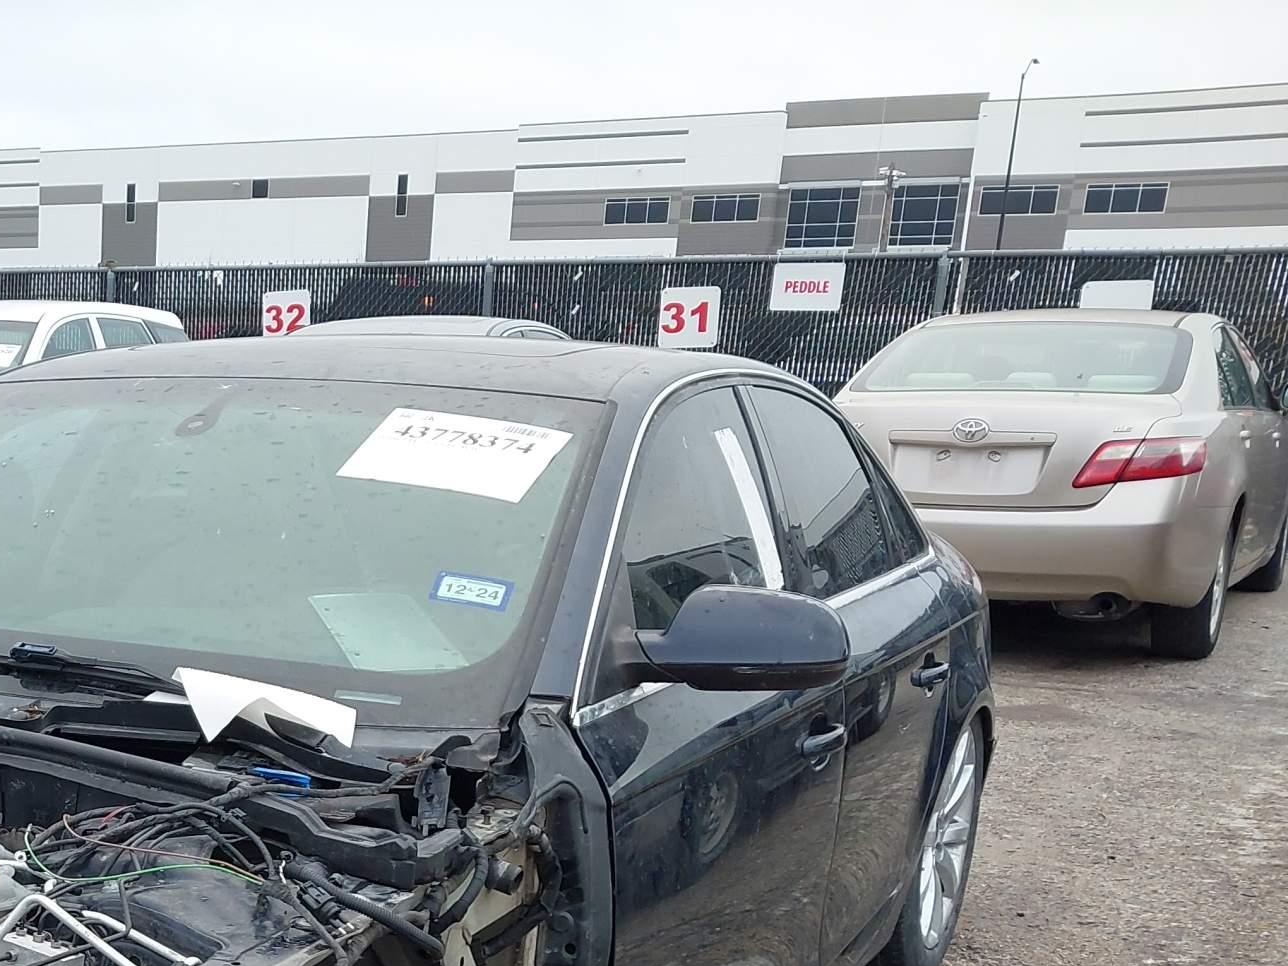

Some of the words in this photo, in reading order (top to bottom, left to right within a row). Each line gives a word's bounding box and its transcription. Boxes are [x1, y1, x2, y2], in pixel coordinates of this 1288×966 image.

[784, 280, 830, 294] PEDDLE
[264, 303, 306, 334] 32
[661, 301, 710, 334] 31
[394, 424, 536, 454] 43778374
